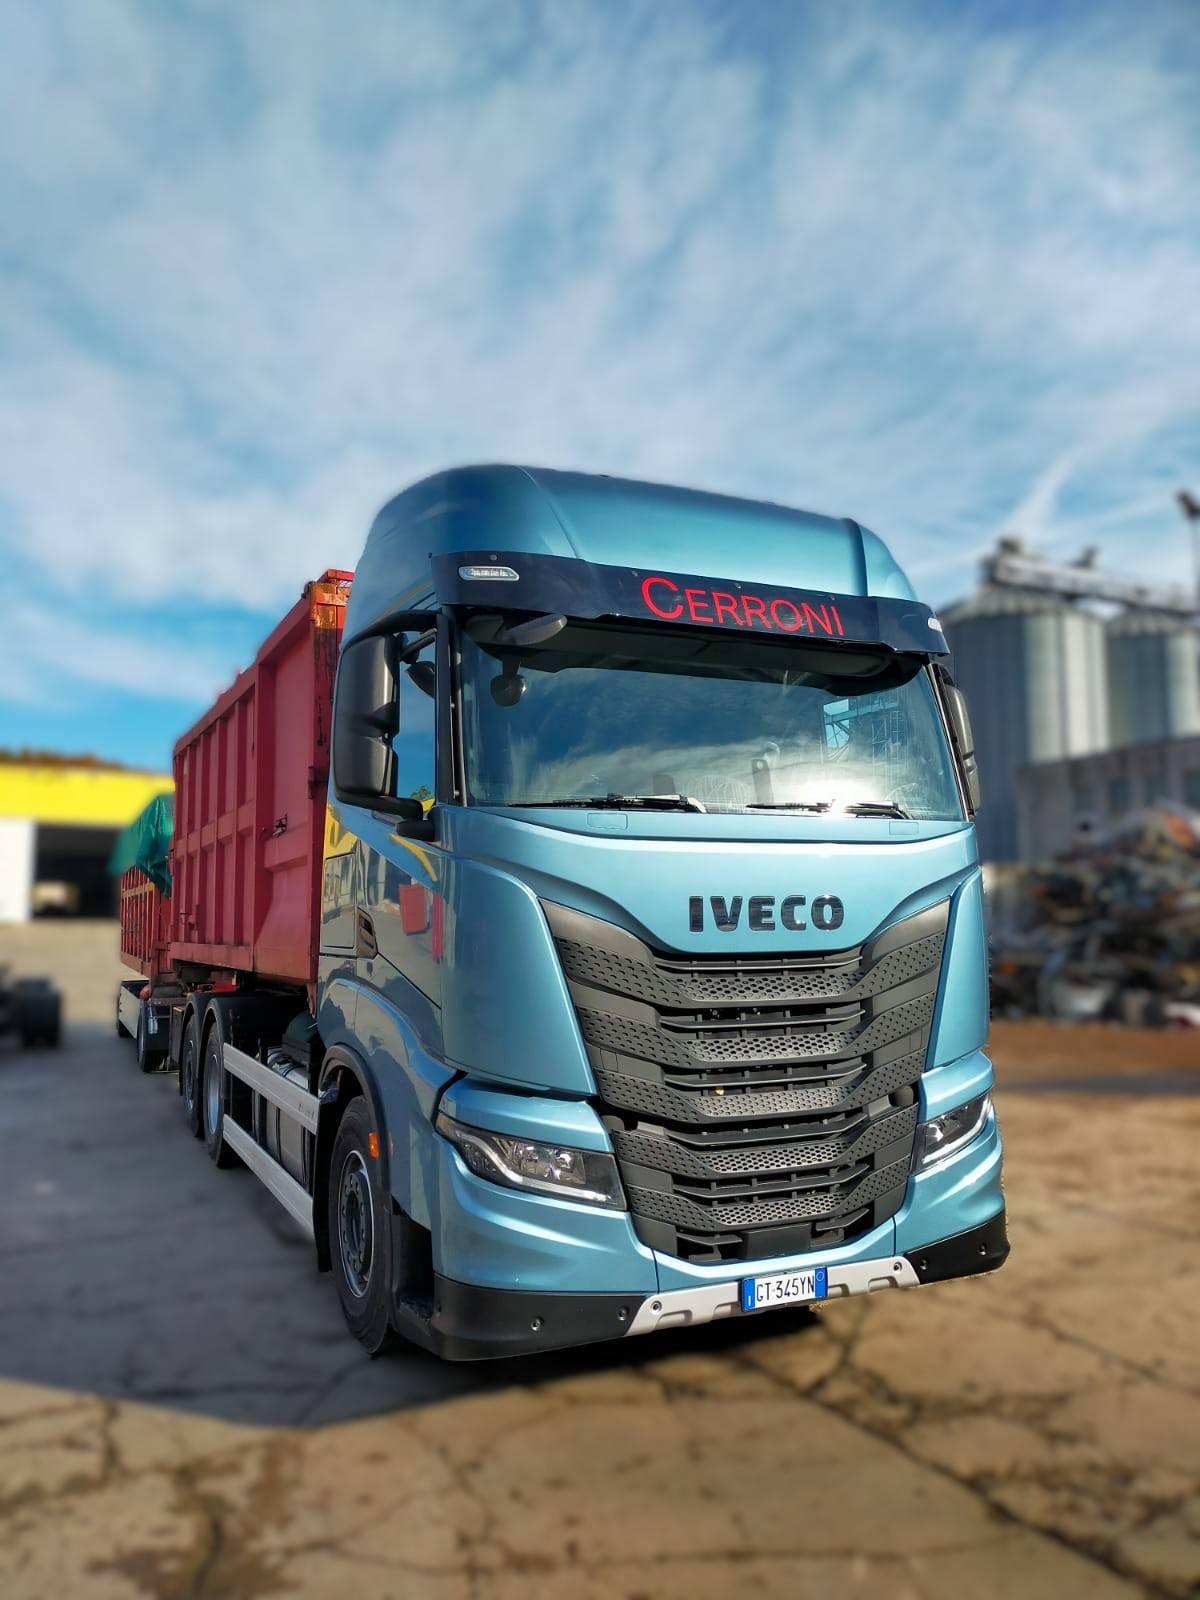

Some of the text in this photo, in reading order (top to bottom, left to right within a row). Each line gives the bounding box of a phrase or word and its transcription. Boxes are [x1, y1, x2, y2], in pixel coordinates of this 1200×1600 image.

[641, 577, 845, 636] CERRONI
[688, 894, 845, 932] IVECO
[756, 1283, 771, 1302] GT
[776, 1275, 815, 1299] 345YN
